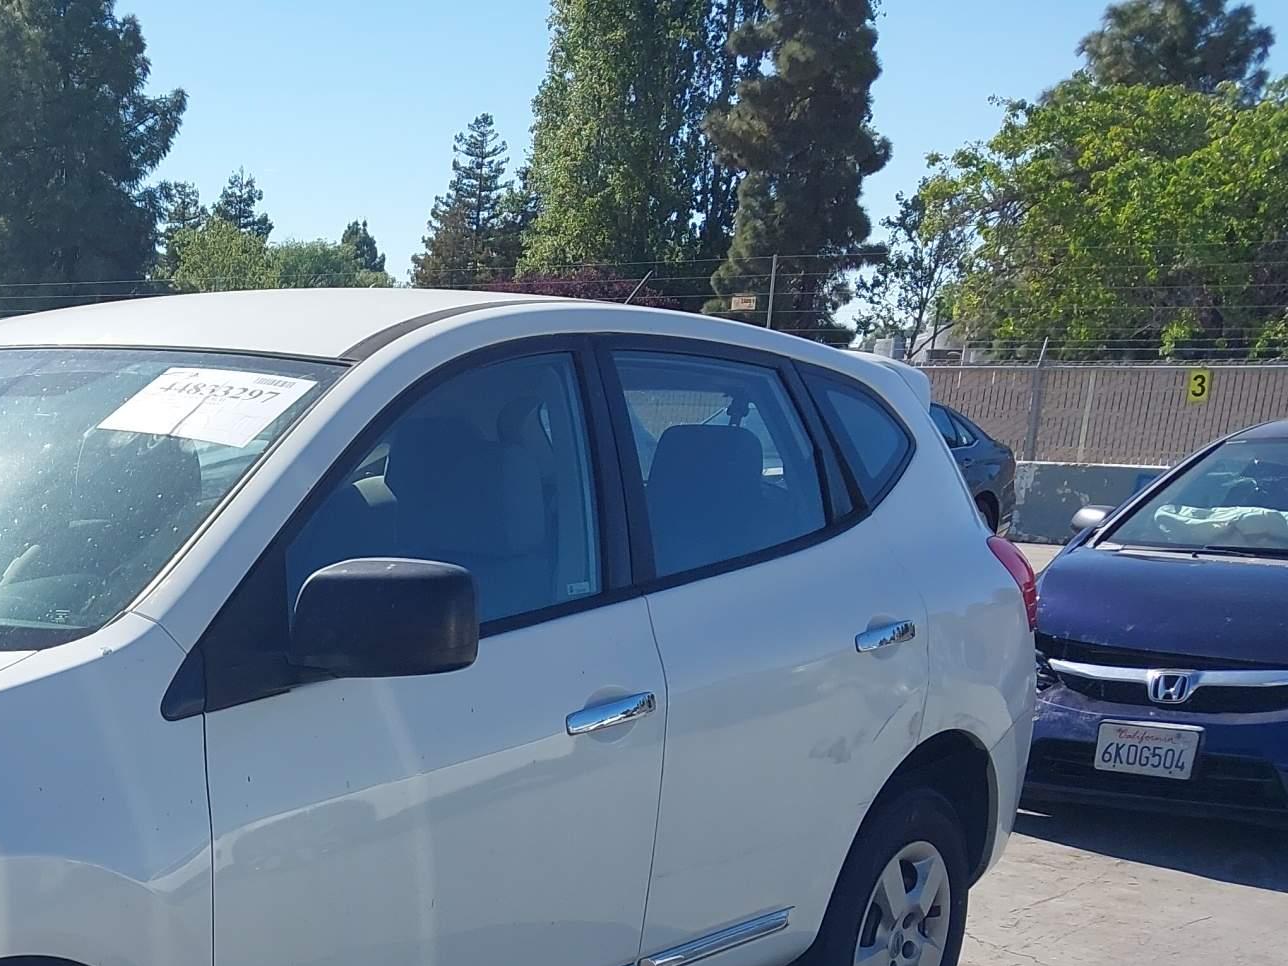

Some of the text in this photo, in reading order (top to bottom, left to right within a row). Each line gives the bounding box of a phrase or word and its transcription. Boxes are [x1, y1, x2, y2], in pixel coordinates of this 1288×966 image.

[160, 381, 281, 404] 44833297
[1191, 374, 1206, 397] 3
[1117, 727, 1177, 744] California
